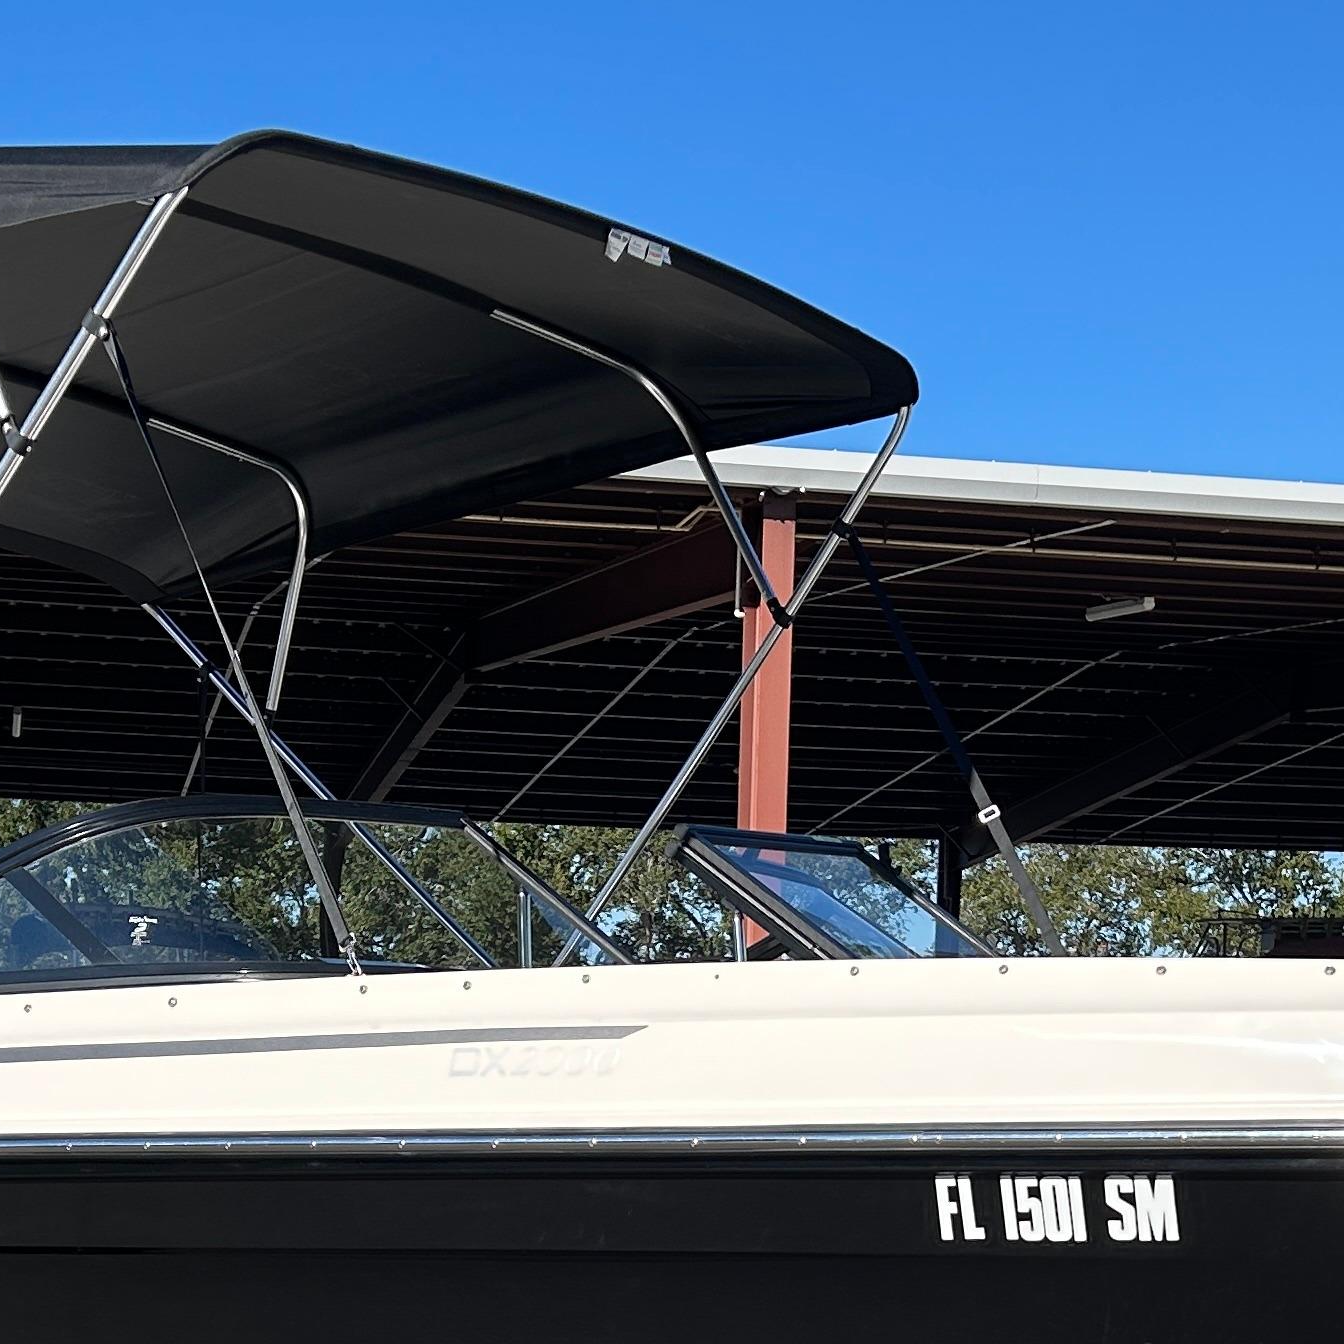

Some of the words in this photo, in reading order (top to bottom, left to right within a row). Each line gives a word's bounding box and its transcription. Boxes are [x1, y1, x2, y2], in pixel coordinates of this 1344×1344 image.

[934, 1175, 986, 1241] FL
[999, 1175, 1088, 1242] 1501
[1103, 1175, 1180, 1242] SM
